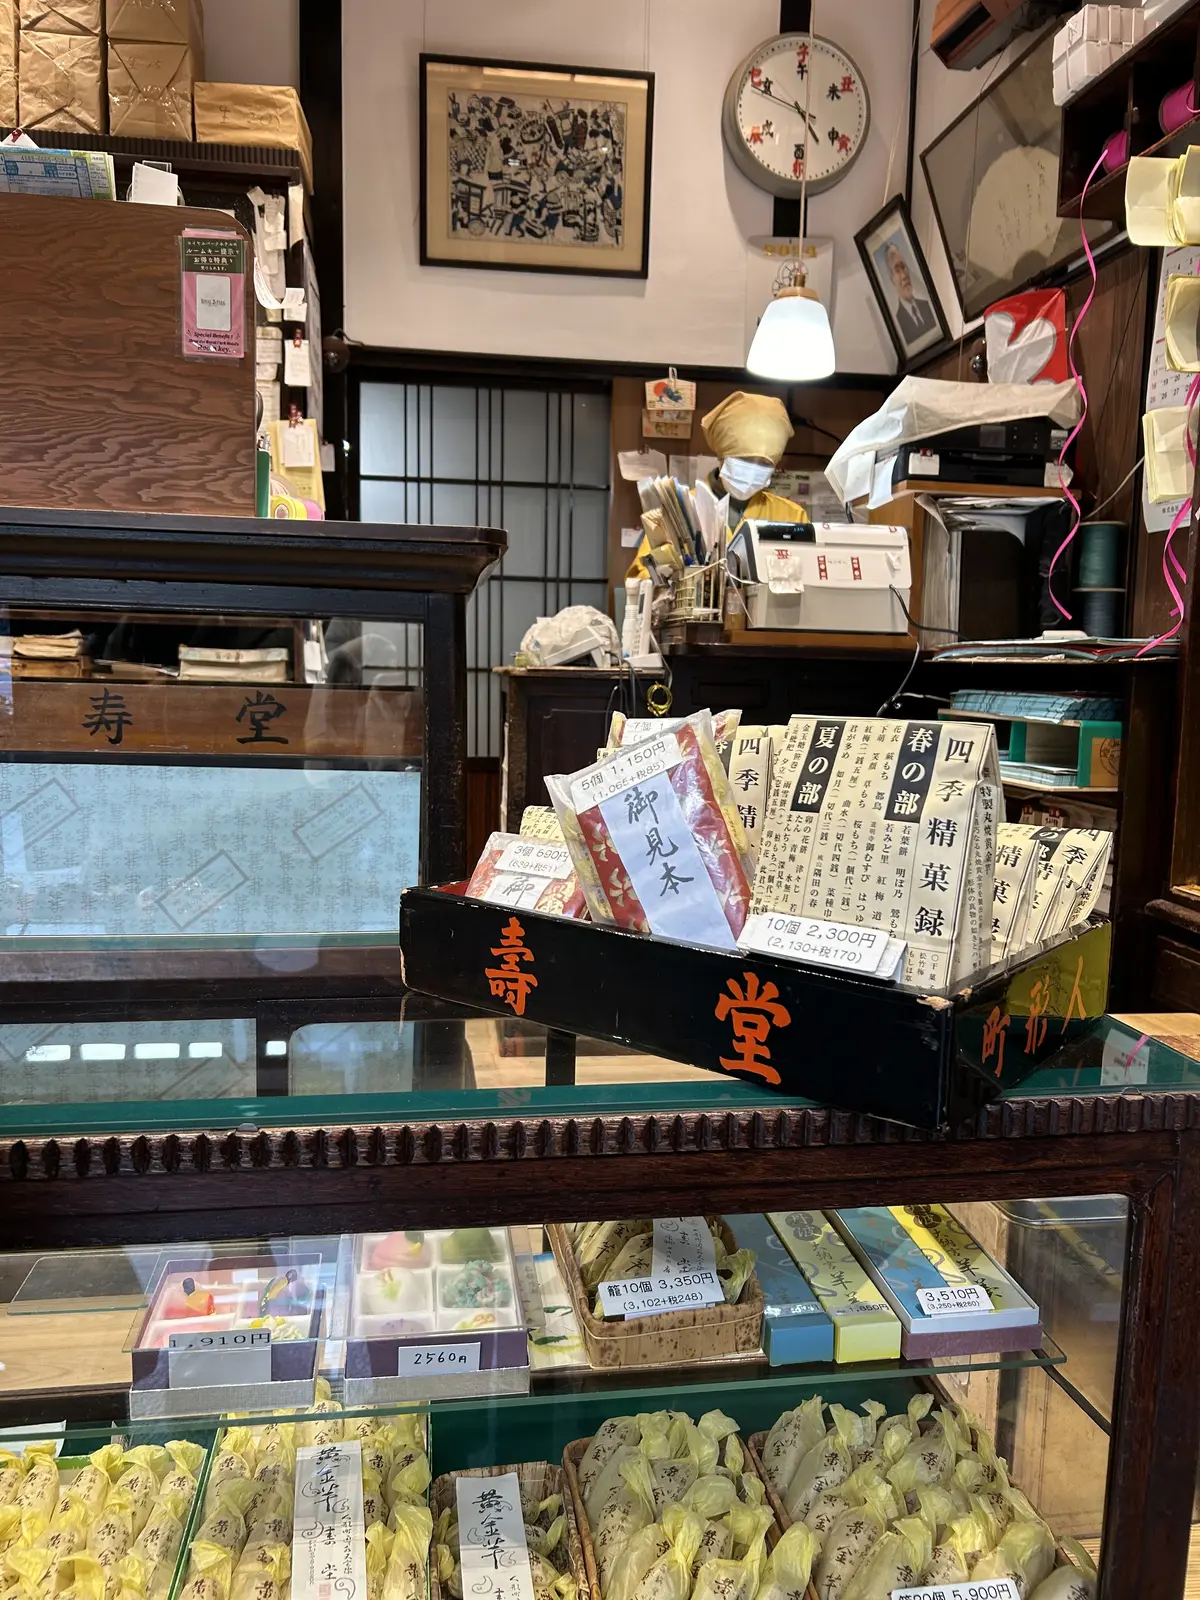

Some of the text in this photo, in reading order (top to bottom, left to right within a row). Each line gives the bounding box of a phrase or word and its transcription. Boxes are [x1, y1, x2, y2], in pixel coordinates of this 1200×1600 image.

[796, 43, 809, 61] 子
[797, 62, 807, 80] 午
[827, 83, 841, 101] 未
[840, 76, 853, 92] 丑
[828, 128, 839, 146] 申
[798, 725, 840, 805] 夏の部
[894, 727, 934, 815] 春の部
[582, 772, 603, 791] 5個
[735, 738, 762, 829] 四季精
[624, 786, 694, 896] 御見本
[914, 737, 974, 937] 四季精菓録
[768, 917, 877, 949] 10個 2,300円
[767, 936, 862, 963] (2,130+税170)
[607, 1272, 714, 1297] 籠10個 3,350円
[925, 1287, 979, 1302] 3,510円
[623, 1292, 703, 1311] (3,102+税248)
[413, 1351, 467, 1365] 2560円
[472, 1489, 505, 1569] 黄金芋
